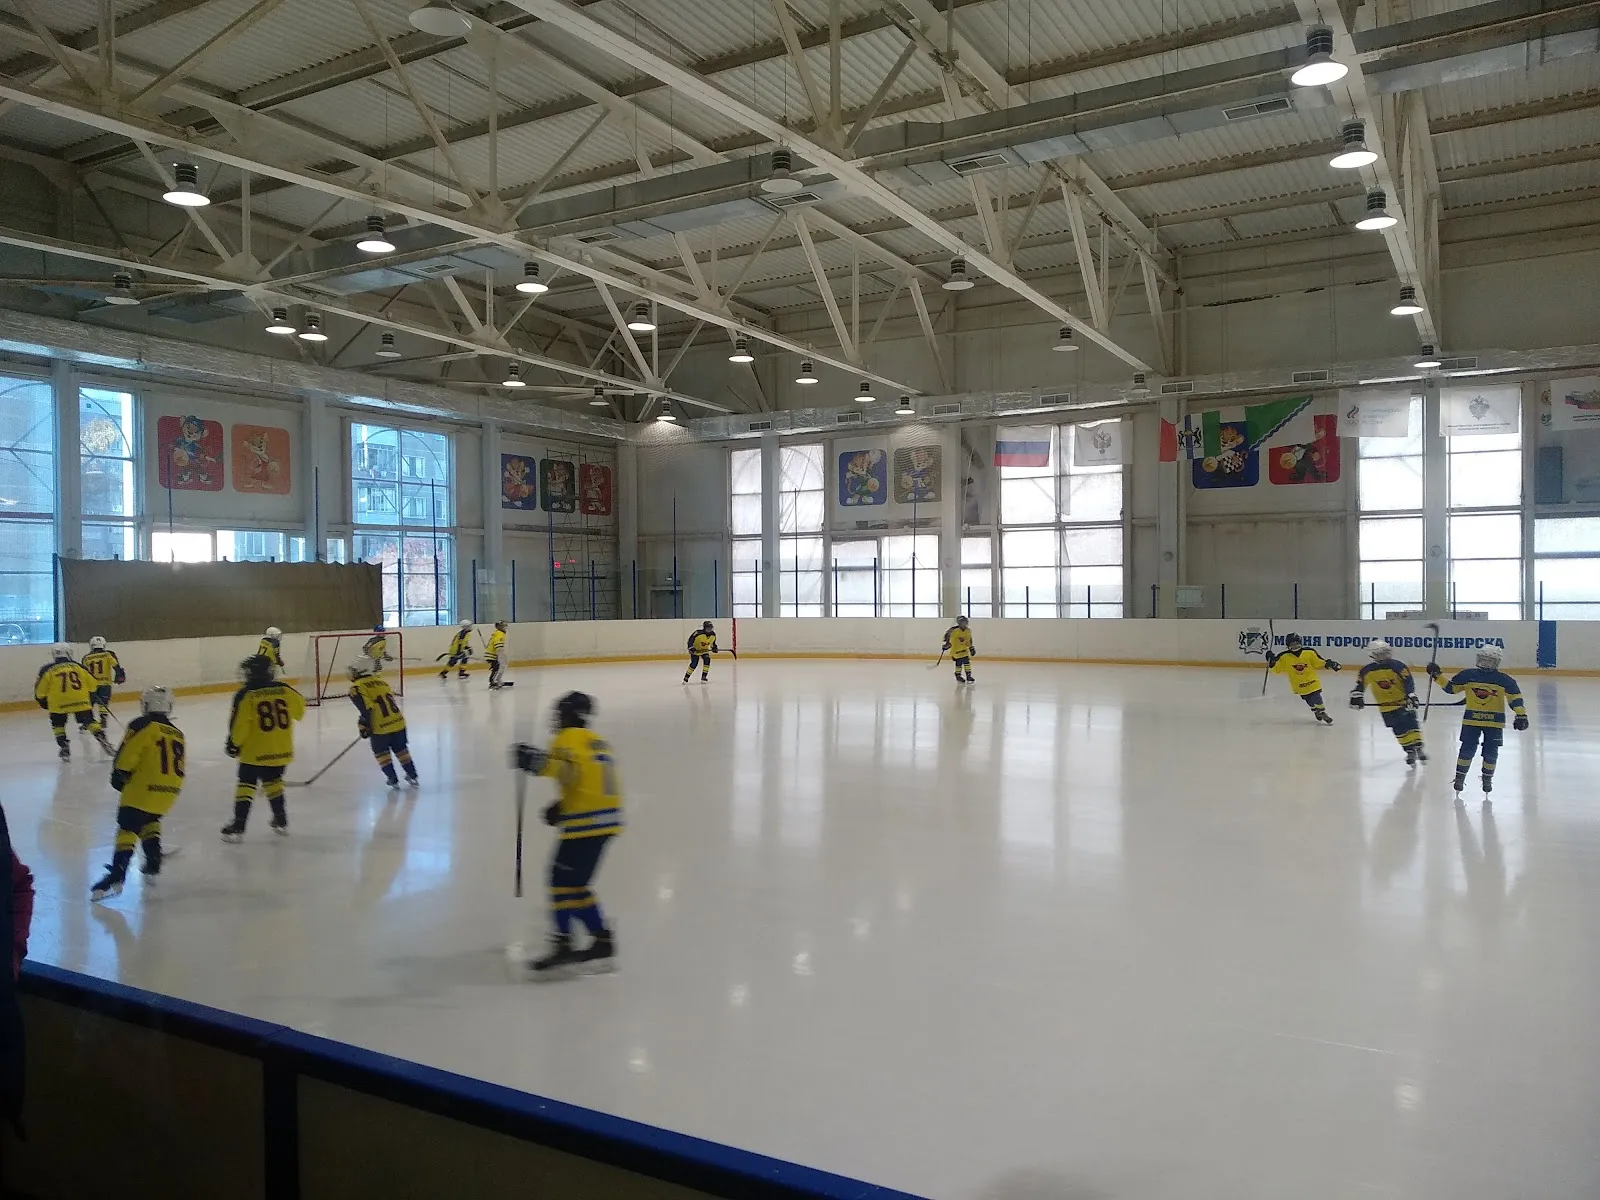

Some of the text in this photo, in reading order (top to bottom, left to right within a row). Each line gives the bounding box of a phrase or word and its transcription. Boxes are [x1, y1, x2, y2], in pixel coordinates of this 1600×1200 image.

[1274, 635, 1505, 649] МИЯ ГОРОД НОВОСИБИРСКА
[89, 660, 104, 675] 11
[55, 671, 83, 693] 79
[257, 698, 291, 732] 86
